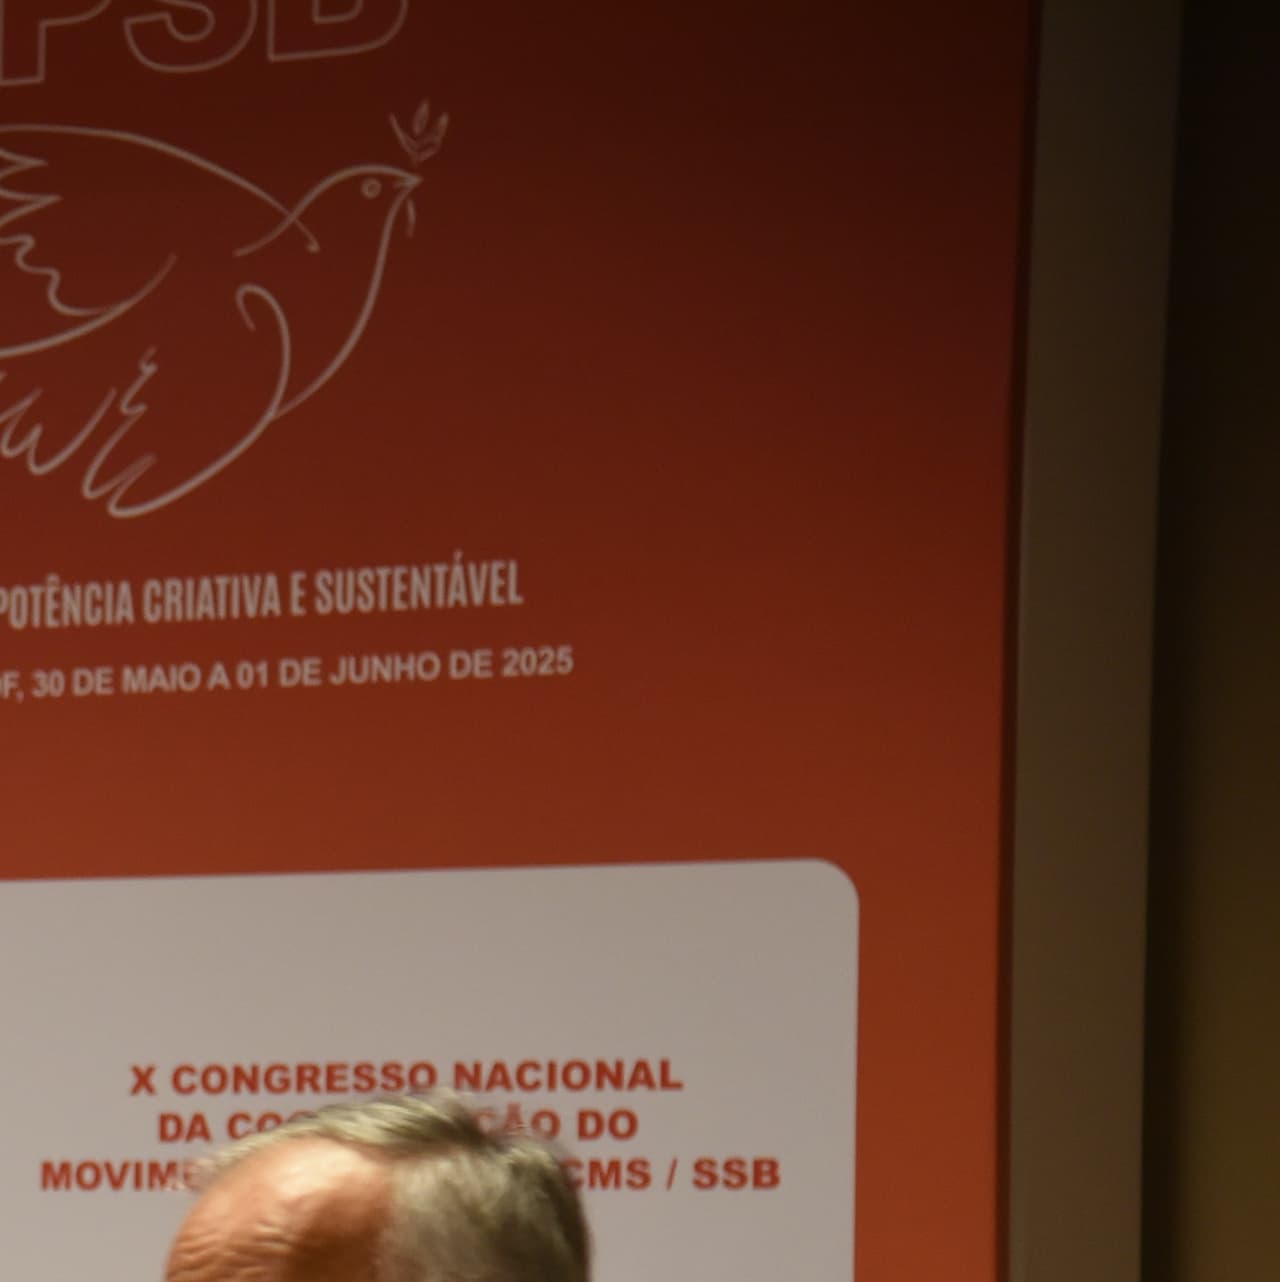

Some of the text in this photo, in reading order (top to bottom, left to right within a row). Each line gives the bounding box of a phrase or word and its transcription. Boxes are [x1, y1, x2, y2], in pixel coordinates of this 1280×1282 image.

[143, 572, 282, 624] CRIATIVA
[290, 571, 307, 616] E
[314, 549, 524, 615] SUSTENTÁVEL
[31, 668, 64, 697] 30
[71, 667, 114, 696] DE
[122, 662, 202, 694] MAIO
[208, 661, 231, 690] A
[237, 660, 269, 688] 01
[279, 657, 321, 687] DE
[330, 650, 441, 684] JUNHO
[449, 648, 493, 679] DE
[501, 645, 574, 677] 2025
[130, 1058, 684, 1095] X CONGRESSO NACIONAL
[159, 1112, 211, 1144] DA
[577, 1108, 639, 1141] DO
[40, 1159, 204, 1192] MOVIM
[666, 1156, 679, 1191] /
[692, 1156, 781, 1191] SSB
